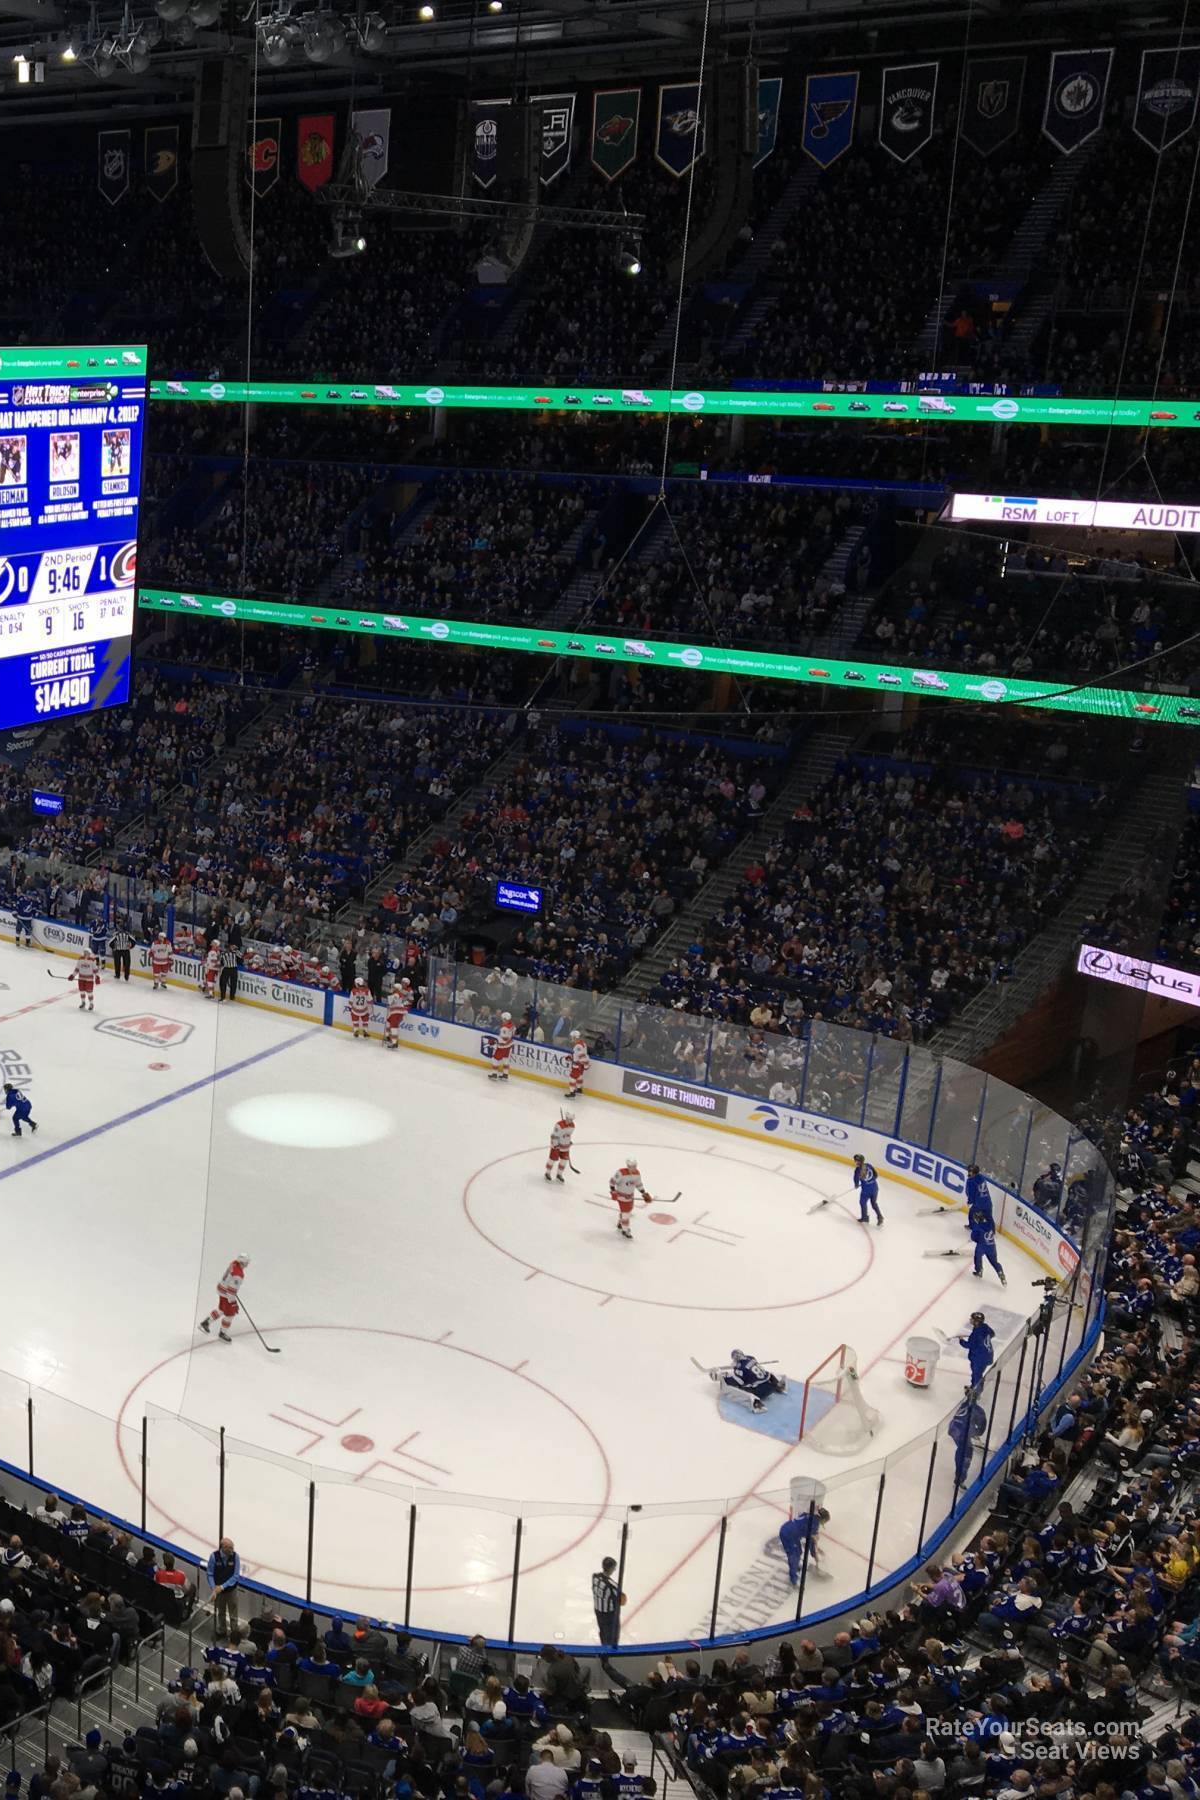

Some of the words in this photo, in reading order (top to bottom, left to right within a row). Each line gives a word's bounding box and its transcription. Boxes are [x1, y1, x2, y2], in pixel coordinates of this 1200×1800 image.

[887, 88, 930, 105] VANCOUVER
[23, 396, 70, 405] CHALLENGE
[72, 388, 106, 398] enterprise
[13, 409, 58, 429] HAPPENED
[57, 408, 71, 426] ON
[70, 406, 109, 426] JANUARY
[108, 406, 117, 424] 4,
[117, 405, 140, 423] 2011?
[1048, 406, 1082, 415] Enterprise
[52, 486, 77, 497] ROLOSON
[104, 481, 127, 492] STAMKOS
[1002, 507, 1037, 521] RSM
[1046, 511, 1080, 523] LOFT
[1132, 507, 1200, 528] AUDIT
[44, 554, 64, 567] 2ND
[65, 551, 92, 565] Period
[99, 555, 107, 581] 1
[18, 566, 29, 593] 0
[48, 566, 80, 595] 9:46
[68, 601, 90, 612] SHOTS
[99, 596, 128, 606] PENALTY
[38, 606, 61, 617] SHOTS
[45, 616, 53, 636] 9
[73, 611, 85, 631] 16
[64, 646, 88, 657] DRAWING
[30, 656, 69, 680] CURRENT
[70, 652, 95, 672] TOTAL
[726, 657, 754, 667] Enterprise
[34, 676, 90, 714] $14490
[499, 886, 527, 899] Sagicor
[47, 928, 61, 938] FOX
[65, 932, 85, 946] SUN
[1116, 963, 1193, 994] LEXUS
[272, 983, 313, 1009] Times
[355, 995, 366, 1006] 23
[104, 1023, 169, 1045] MARATHON
[651, 1083, 663, 1096] BE
[662, 1086, 678, 1100] THE
[678, 1089, 717, 1111] THUNDER
[784, 1112, 849, 1141] TECO
[885, 1143, 966, 1194] GEIC
